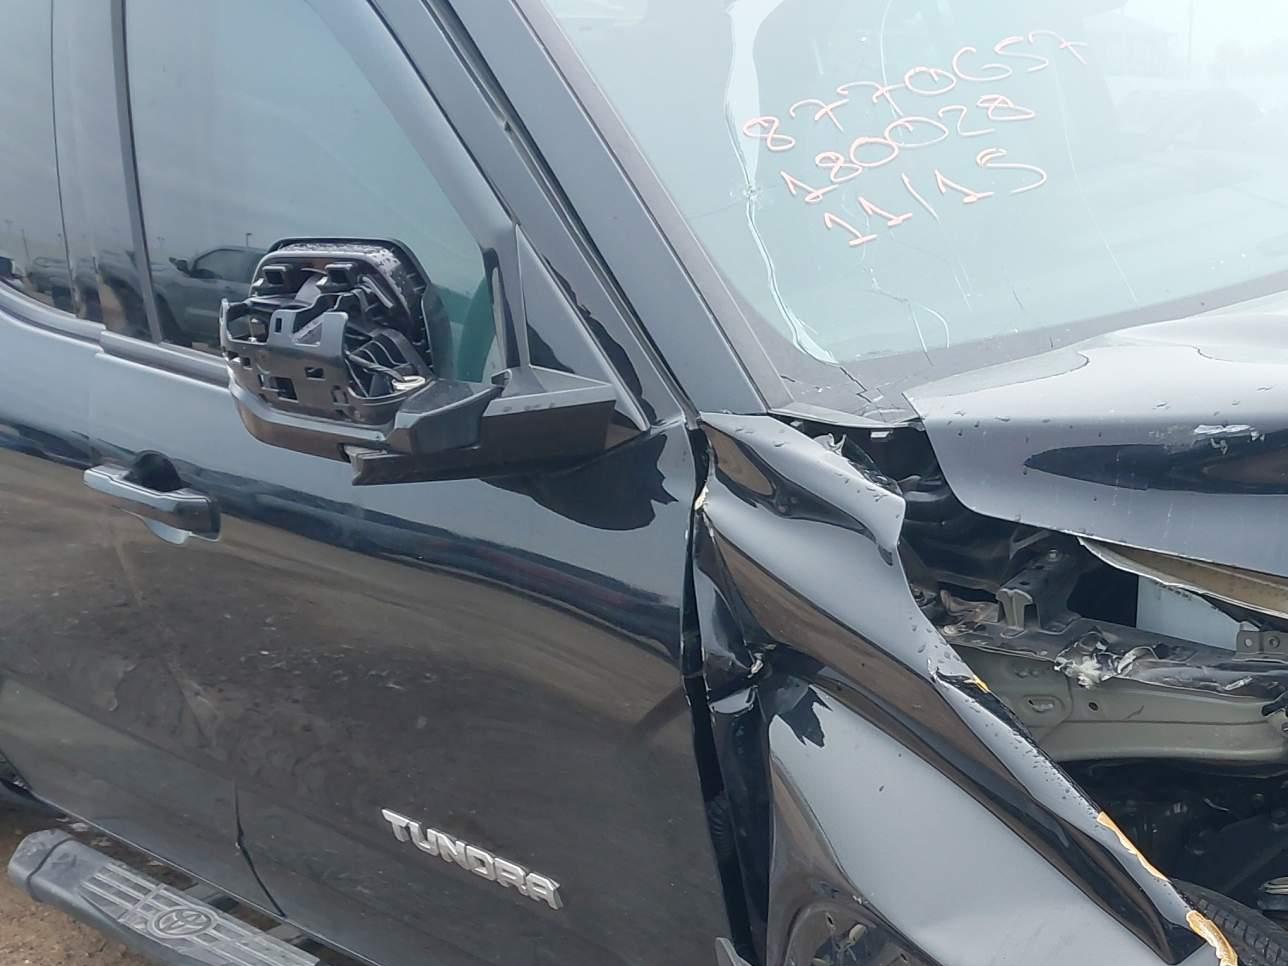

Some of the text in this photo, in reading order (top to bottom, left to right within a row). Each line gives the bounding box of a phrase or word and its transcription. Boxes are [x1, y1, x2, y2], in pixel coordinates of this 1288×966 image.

[781, 94, 1036, 203] 180028
[824, 148, 1047, 246] 11/15
[381, 809, 563, 910] TUNDRA
